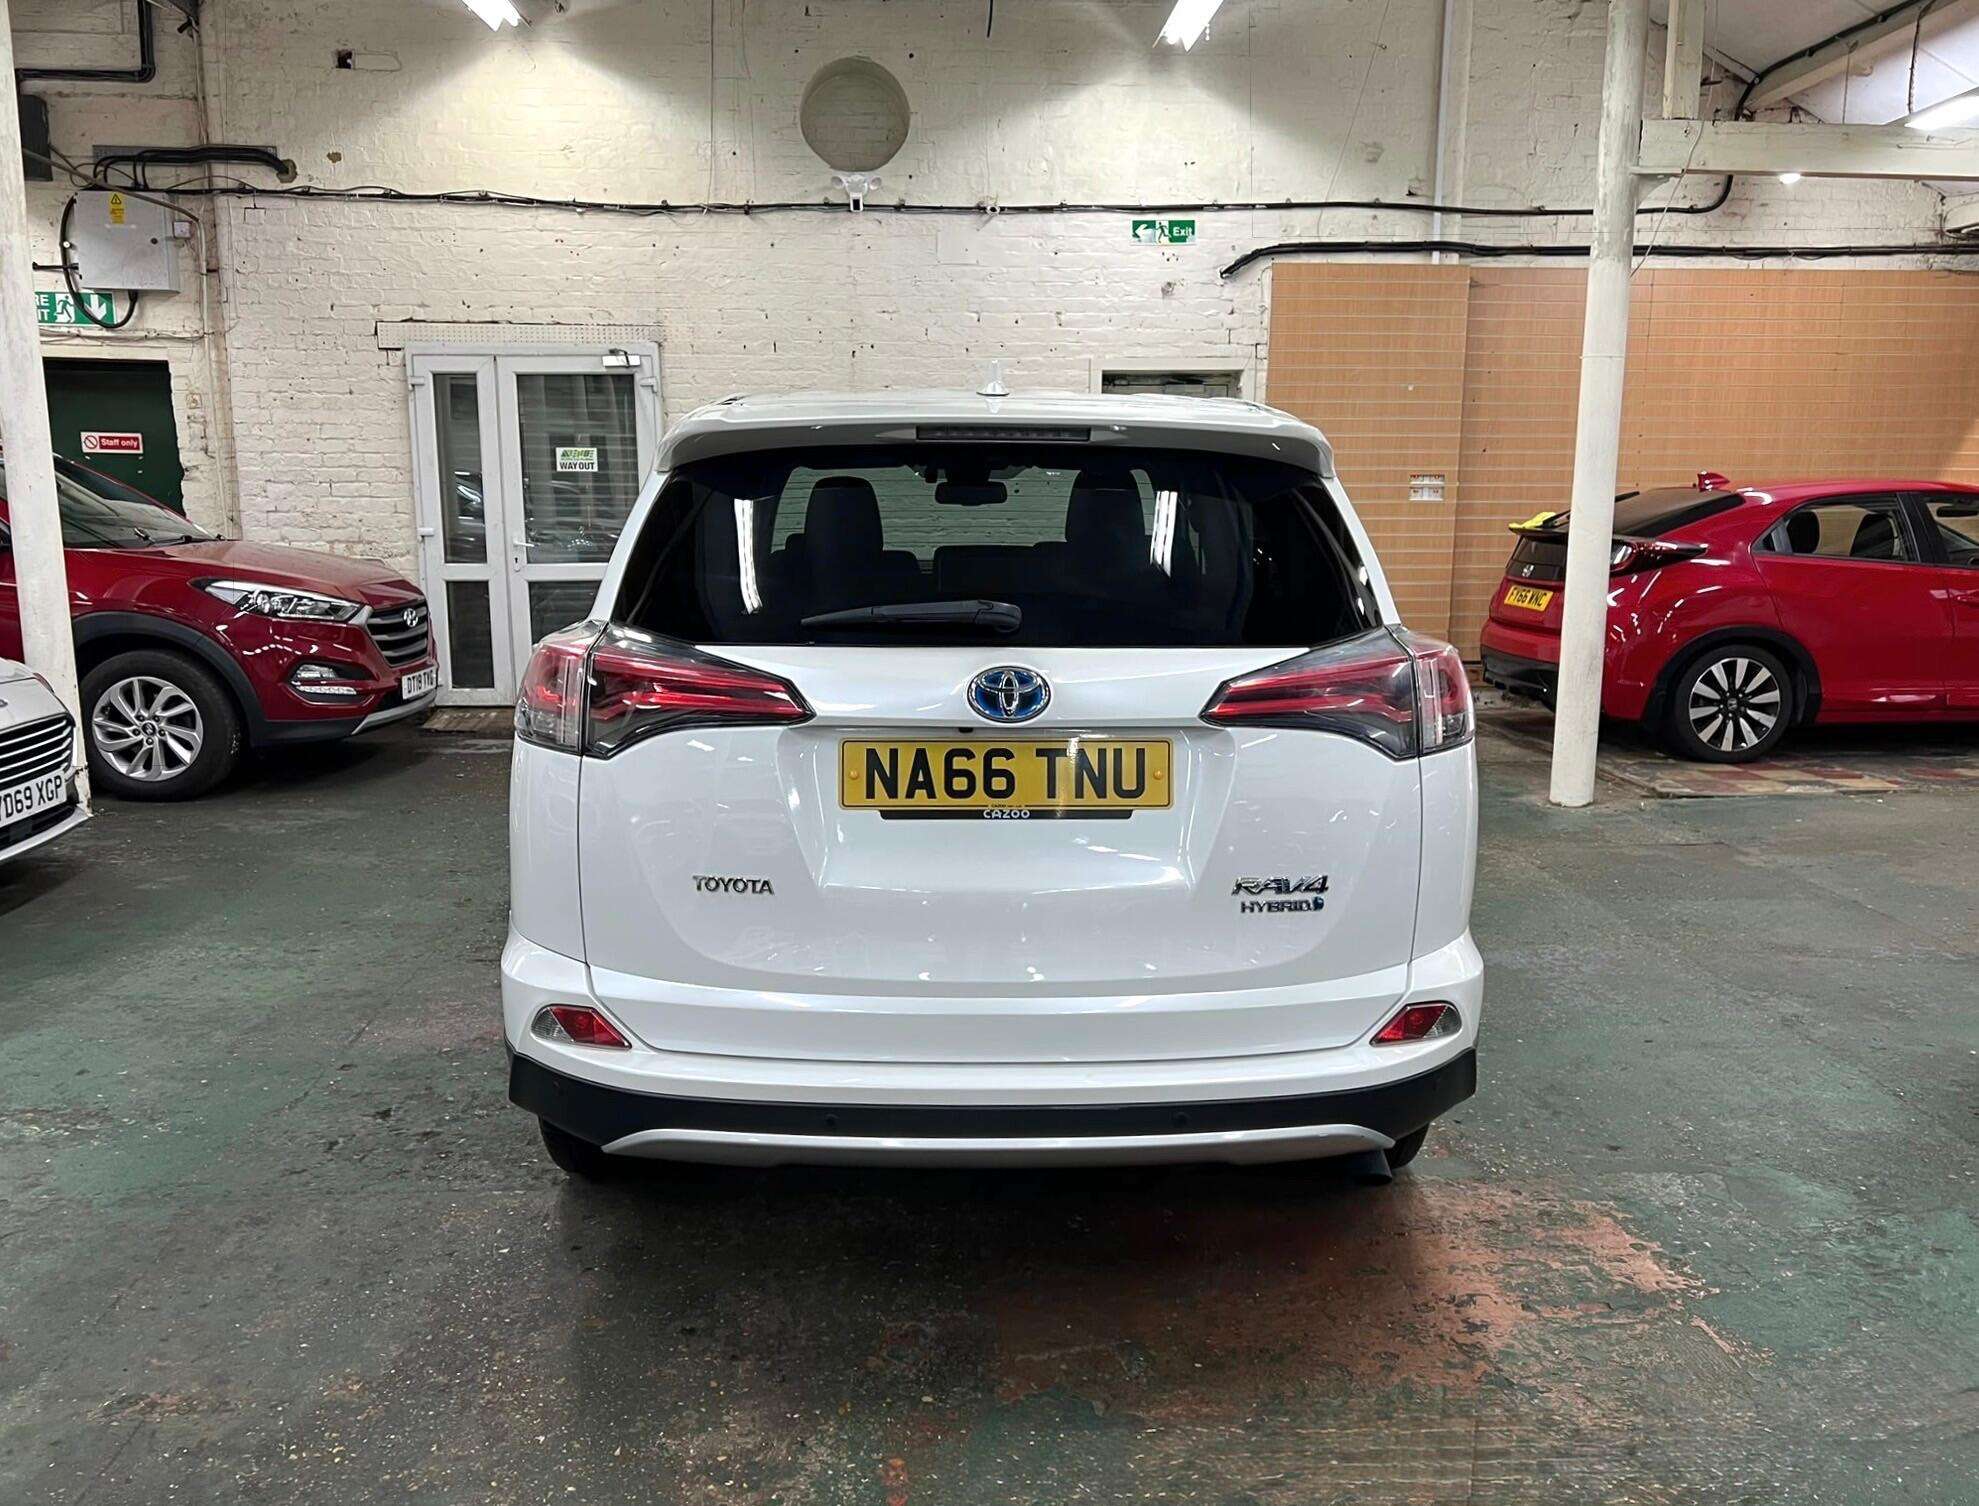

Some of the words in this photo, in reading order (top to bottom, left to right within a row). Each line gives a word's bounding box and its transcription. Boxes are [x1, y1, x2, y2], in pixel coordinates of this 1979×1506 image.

[1172, 226, 1193, 237] Exit
[101, 438, 120, 446] Staff
[120, 439, 138, 449] only
[560, 461, 577, 470] WAY
[578, 461, 595, 470] OUT
[865, 747, 1016, 799] NA66
[1035, 747, 1146, 799] TNU
[0, 786, 33, 820] D69
[36, 775, 62, 806] XGP
[982, 809, 1031, 819] CAZOO
[692, 875, 775, 895] TOYOTA
[1230, 874, 1329, 895] RAV4
[1240, 900, 1312, 913] HYBRID
